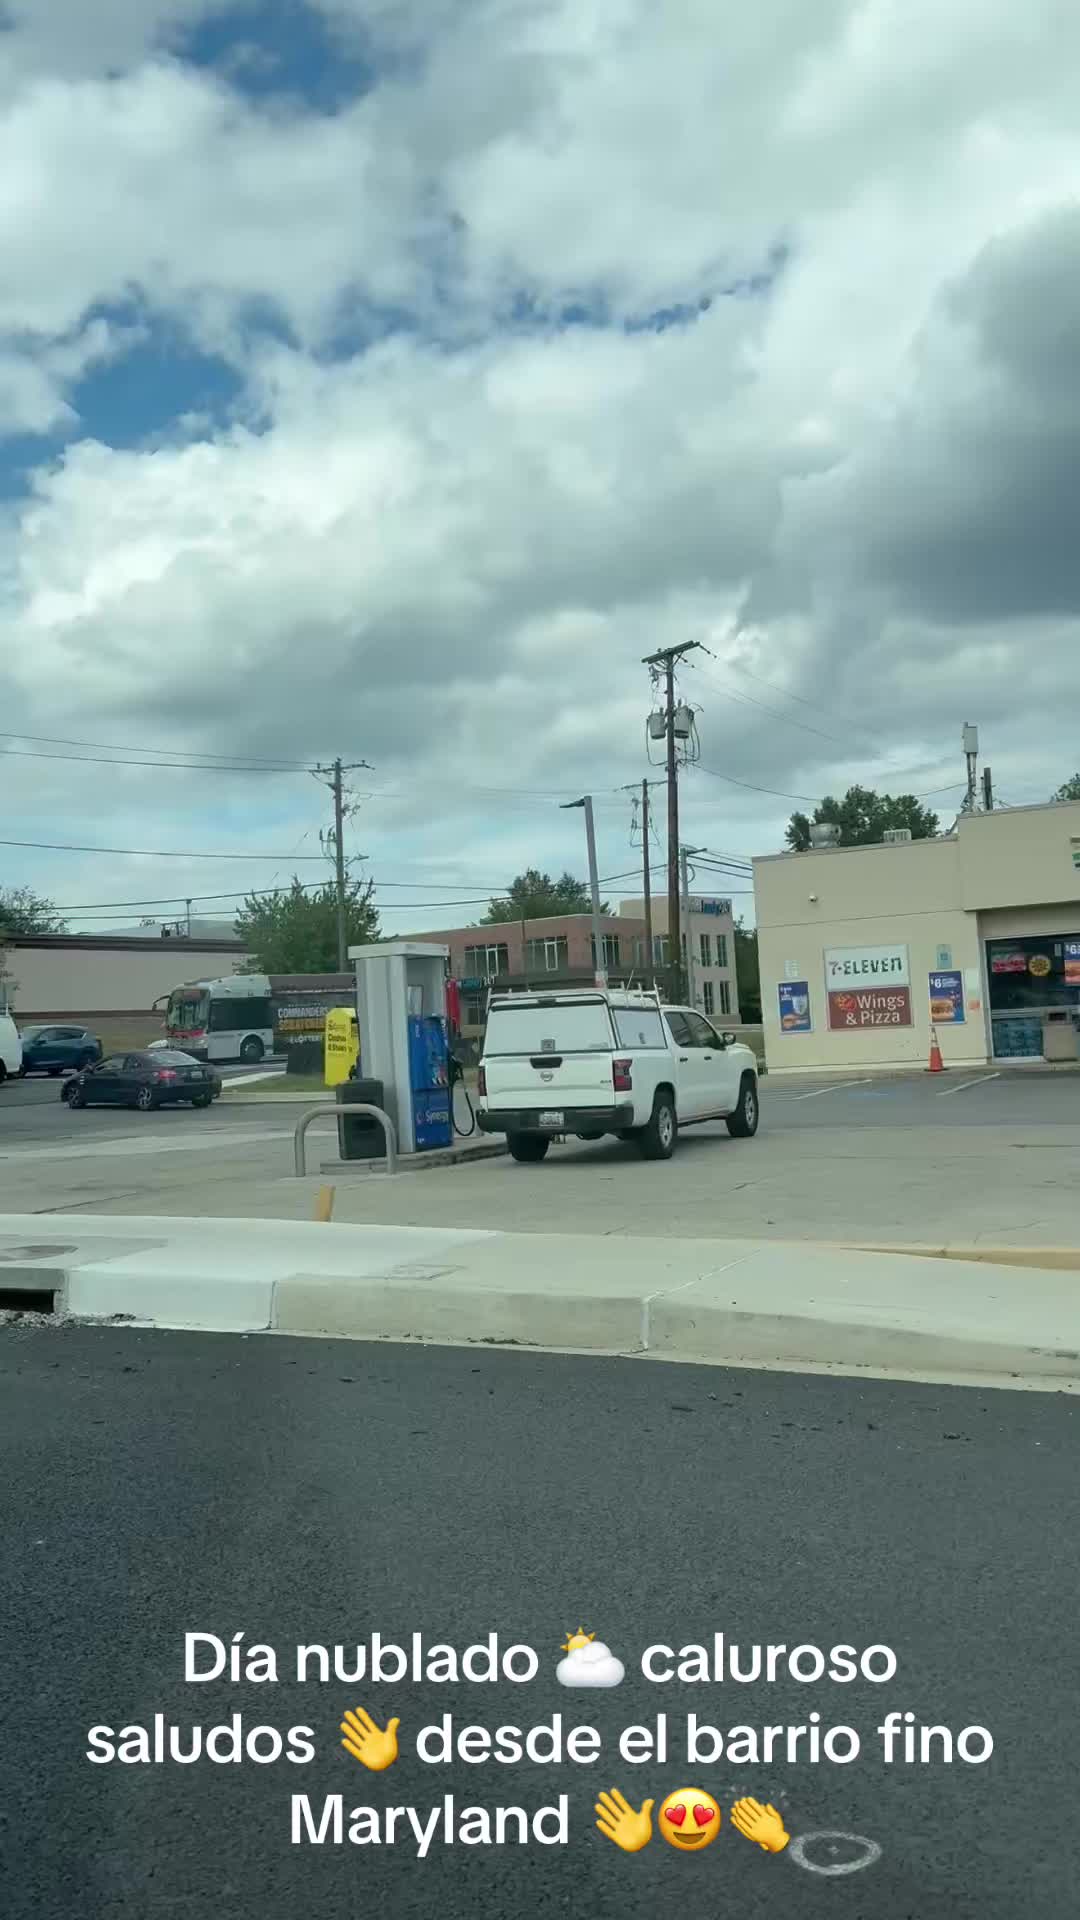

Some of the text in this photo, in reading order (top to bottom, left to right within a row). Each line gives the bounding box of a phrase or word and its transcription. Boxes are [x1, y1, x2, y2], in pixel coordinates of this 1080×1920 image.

[856, 994, 906, 1012] Wings
[846, 1009, 901, 1025] & Pizza
